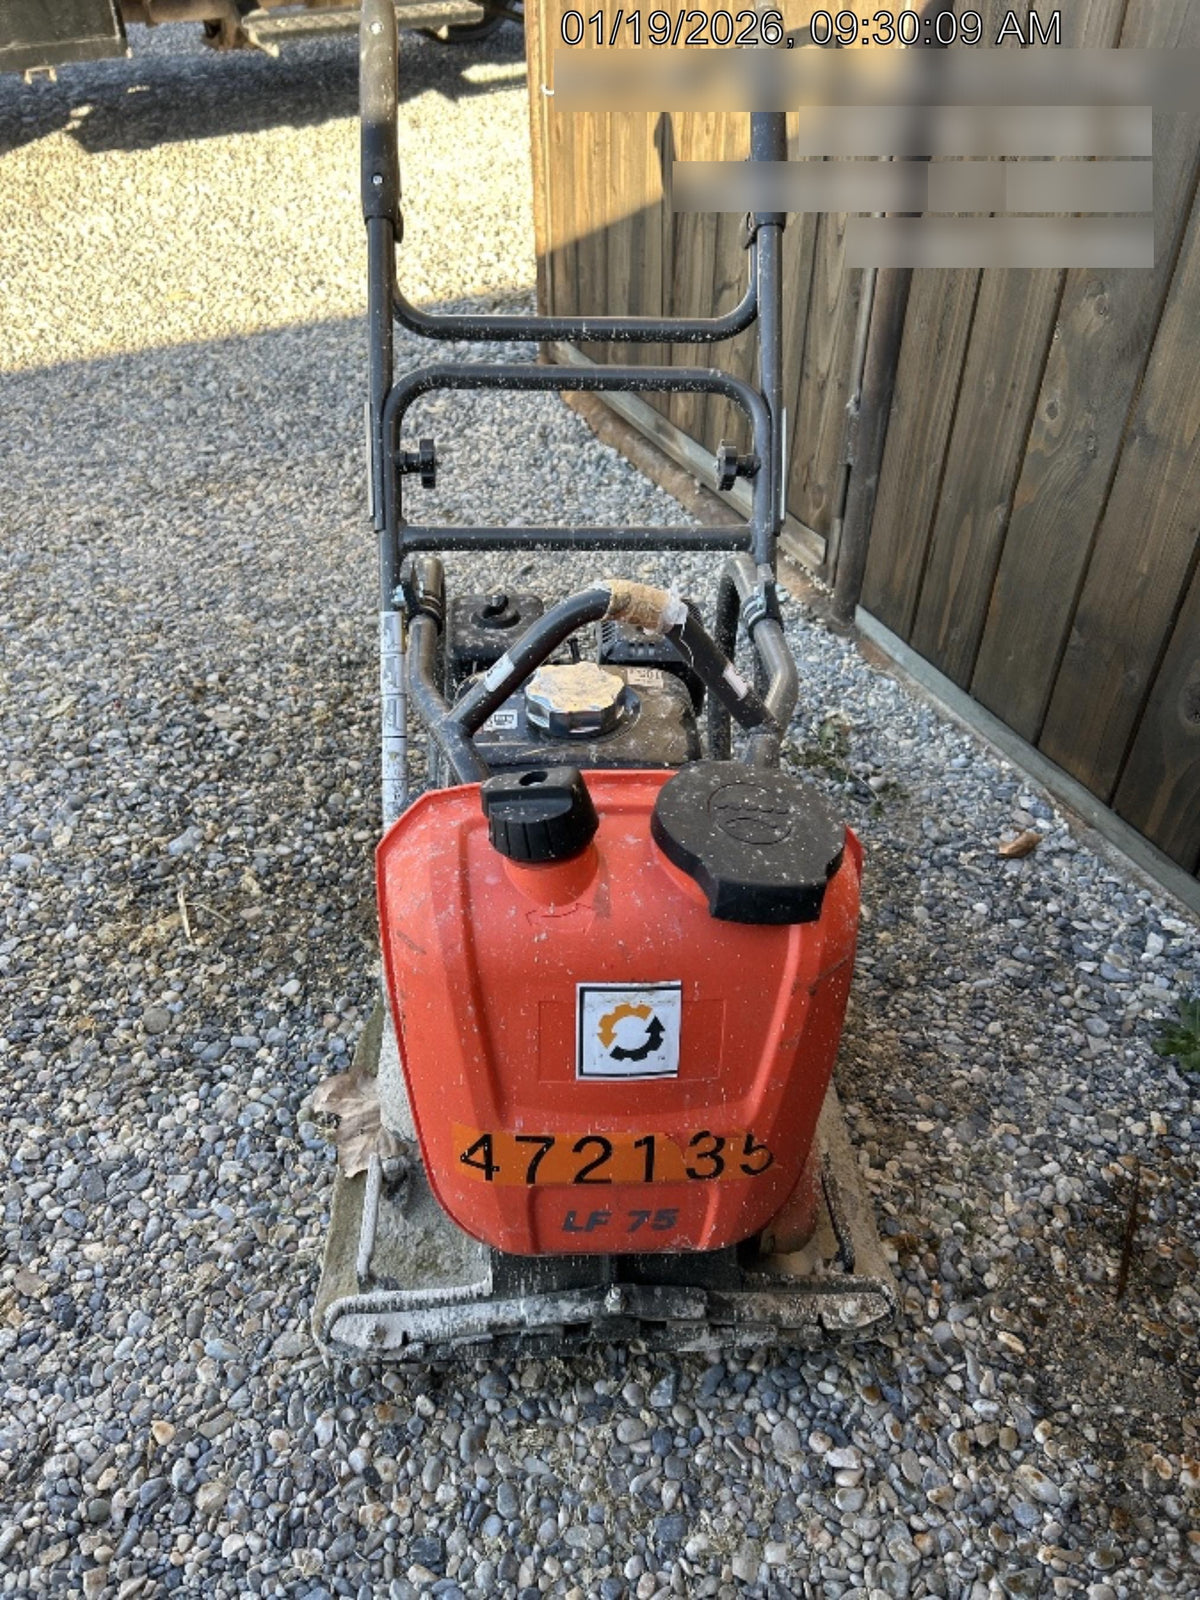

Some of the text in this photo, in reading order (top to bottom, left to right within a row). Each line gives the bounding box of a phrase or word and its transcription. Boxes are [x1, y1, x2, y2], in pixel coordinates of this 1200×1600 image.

[460, 1130, 775, 1185] 472135
[561, 1208, 680, 1233] LF 75
